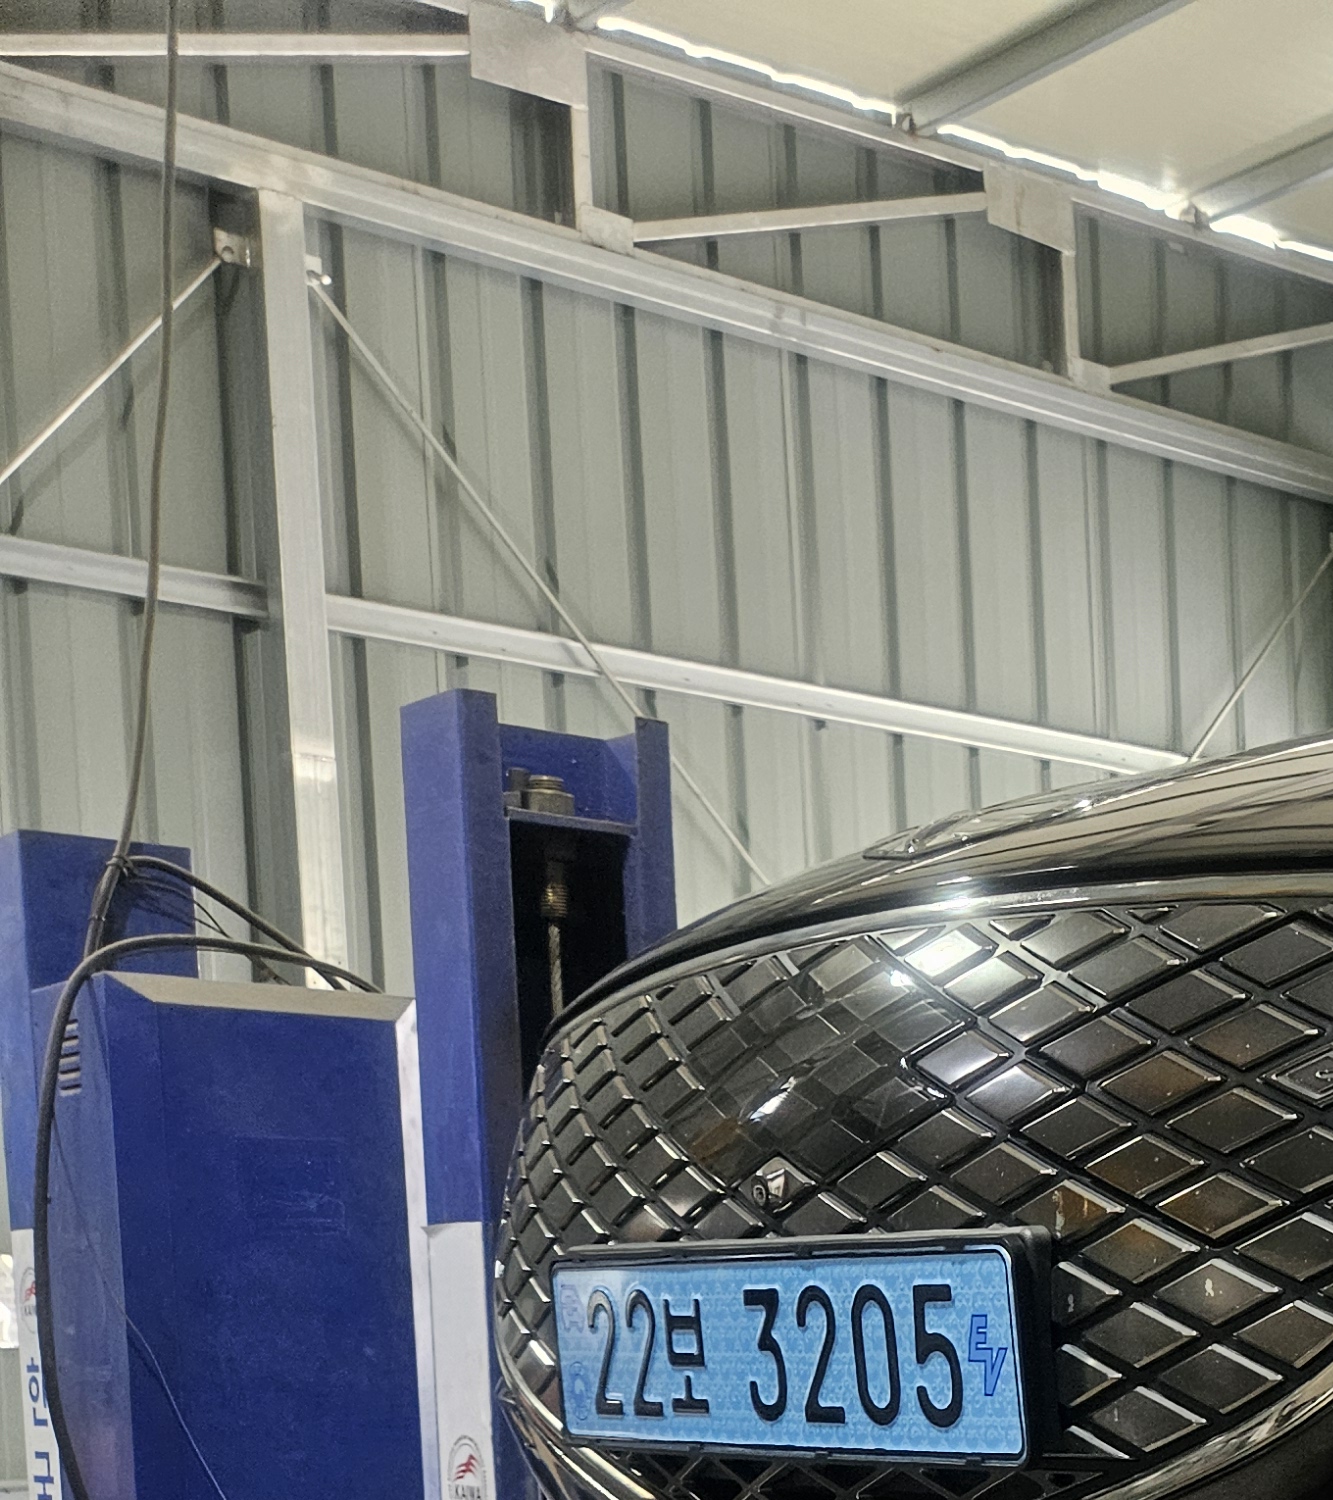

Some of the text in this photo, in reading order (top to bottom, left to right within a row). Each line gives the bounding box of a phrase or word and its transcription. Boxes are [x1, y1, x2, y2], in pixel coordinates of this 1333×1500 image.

[587, 1282, 964, 1429] 22보 3205
[968, 1314, 1008, 1397] EV
